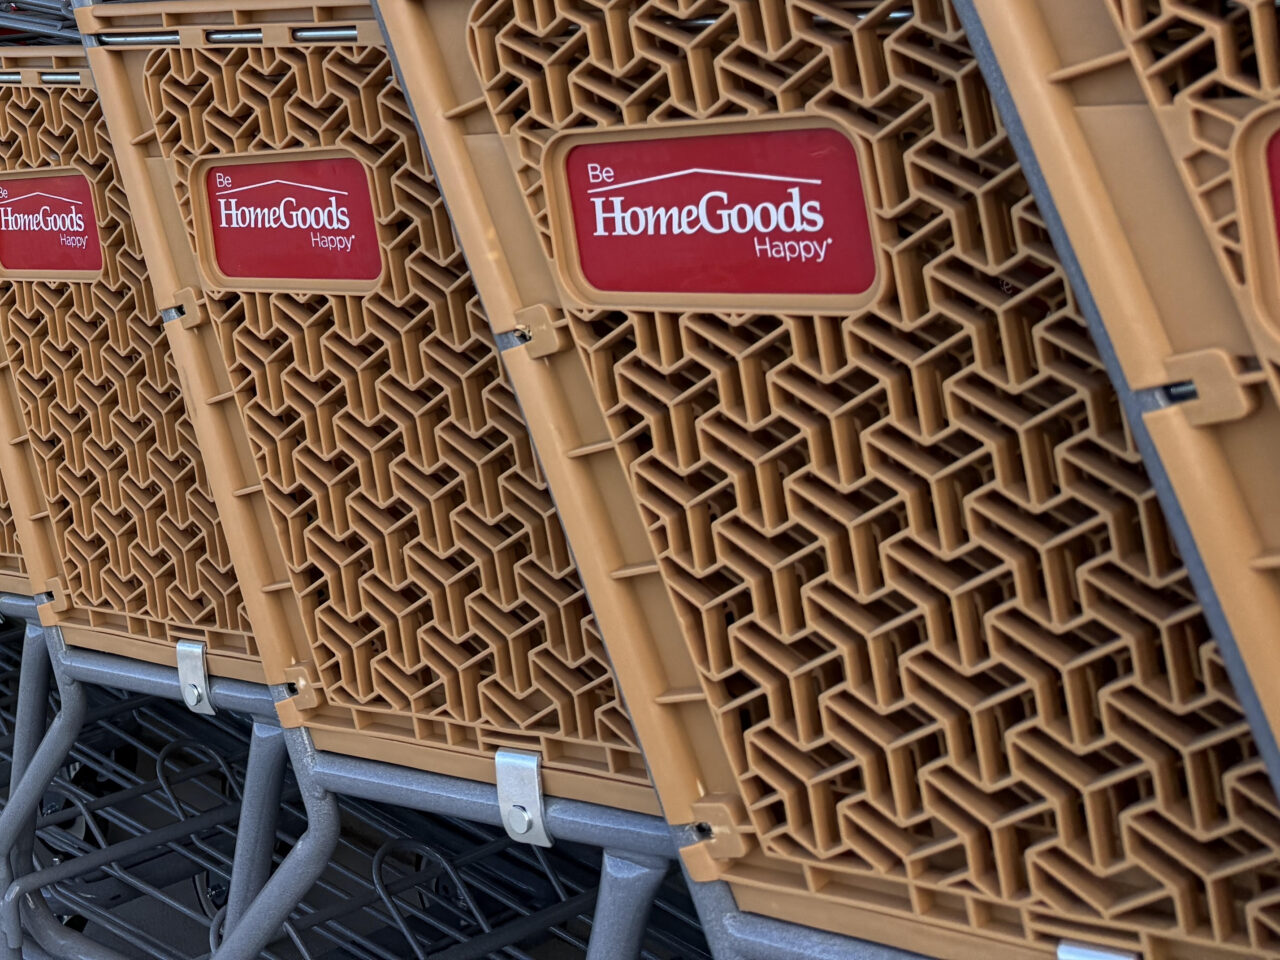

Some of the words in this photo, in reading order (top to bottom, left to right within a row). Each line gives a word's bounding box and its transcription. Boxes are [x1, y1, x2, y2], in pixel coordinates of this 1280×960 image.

[215, 173, 232, 188] Be
[586, 163, 615, 183] Be
[217, 196, 350, 230] HomeGoods
[589, 186, 825, 236] HomeGoods
[59, 233, 88, 249] Happy
[310, 231, 354, 252] Happy
[754, 236, 829, 262] Happy
